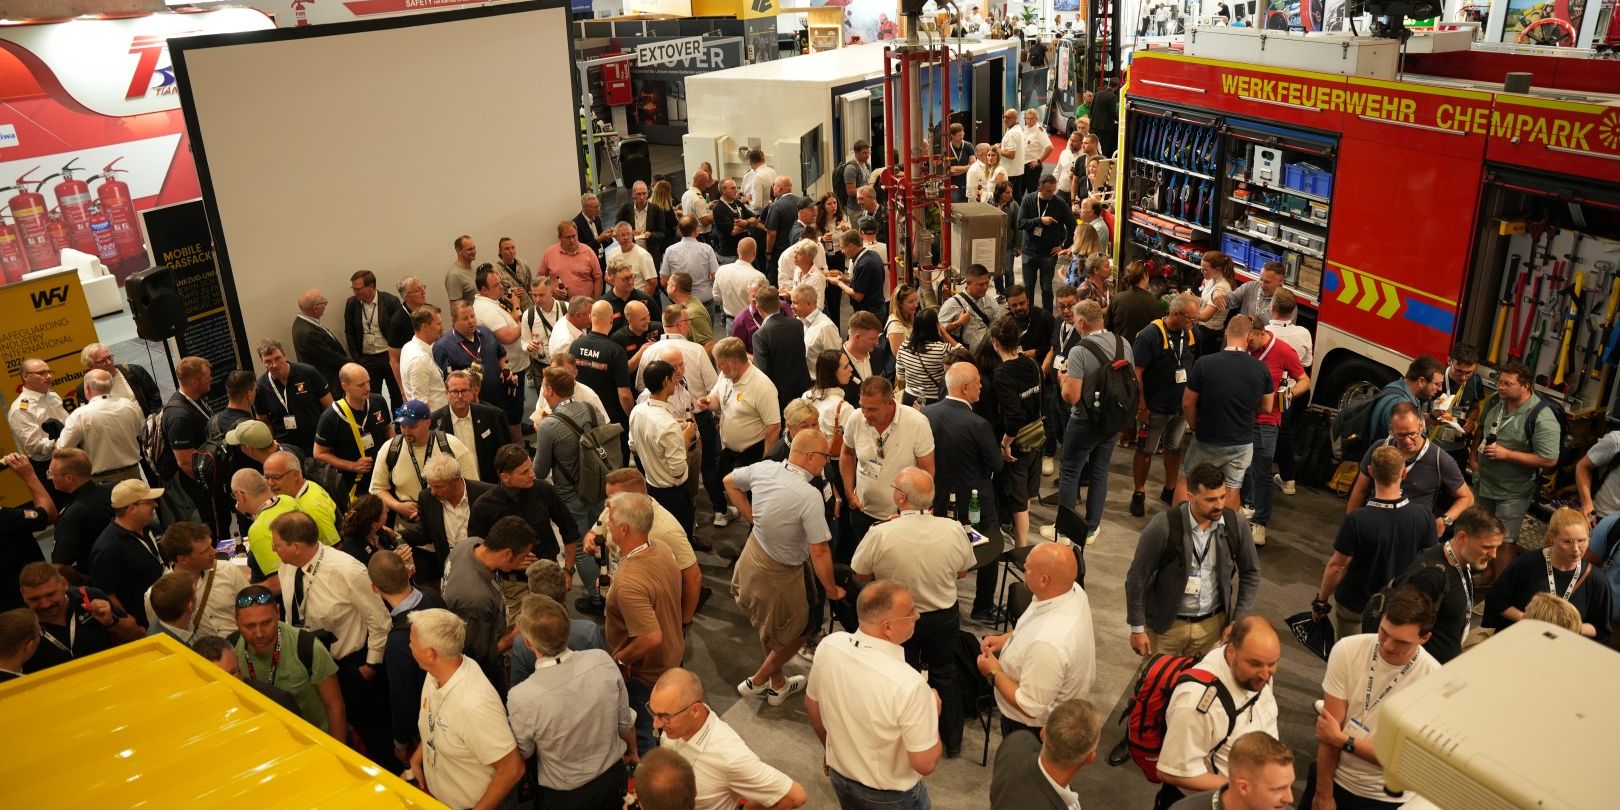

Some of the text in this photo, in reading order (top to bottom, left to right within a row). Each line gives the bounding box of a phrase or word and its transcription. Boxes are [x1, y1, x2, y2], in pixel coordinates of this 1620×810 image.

[640, 40, 701, 63] EXTOVER
[1221, 73, 1595, 151] WERKFEUERWEHR CHEMPARK
[163, 243, 202, 262] MOBILE
[30, 284, 69, 310] WFV
[1, 333, 44, 352] INDUSTRY
[2, 335, 73, 359] INTERNATIONAL
[580, 347, 600, 359] TEAM
